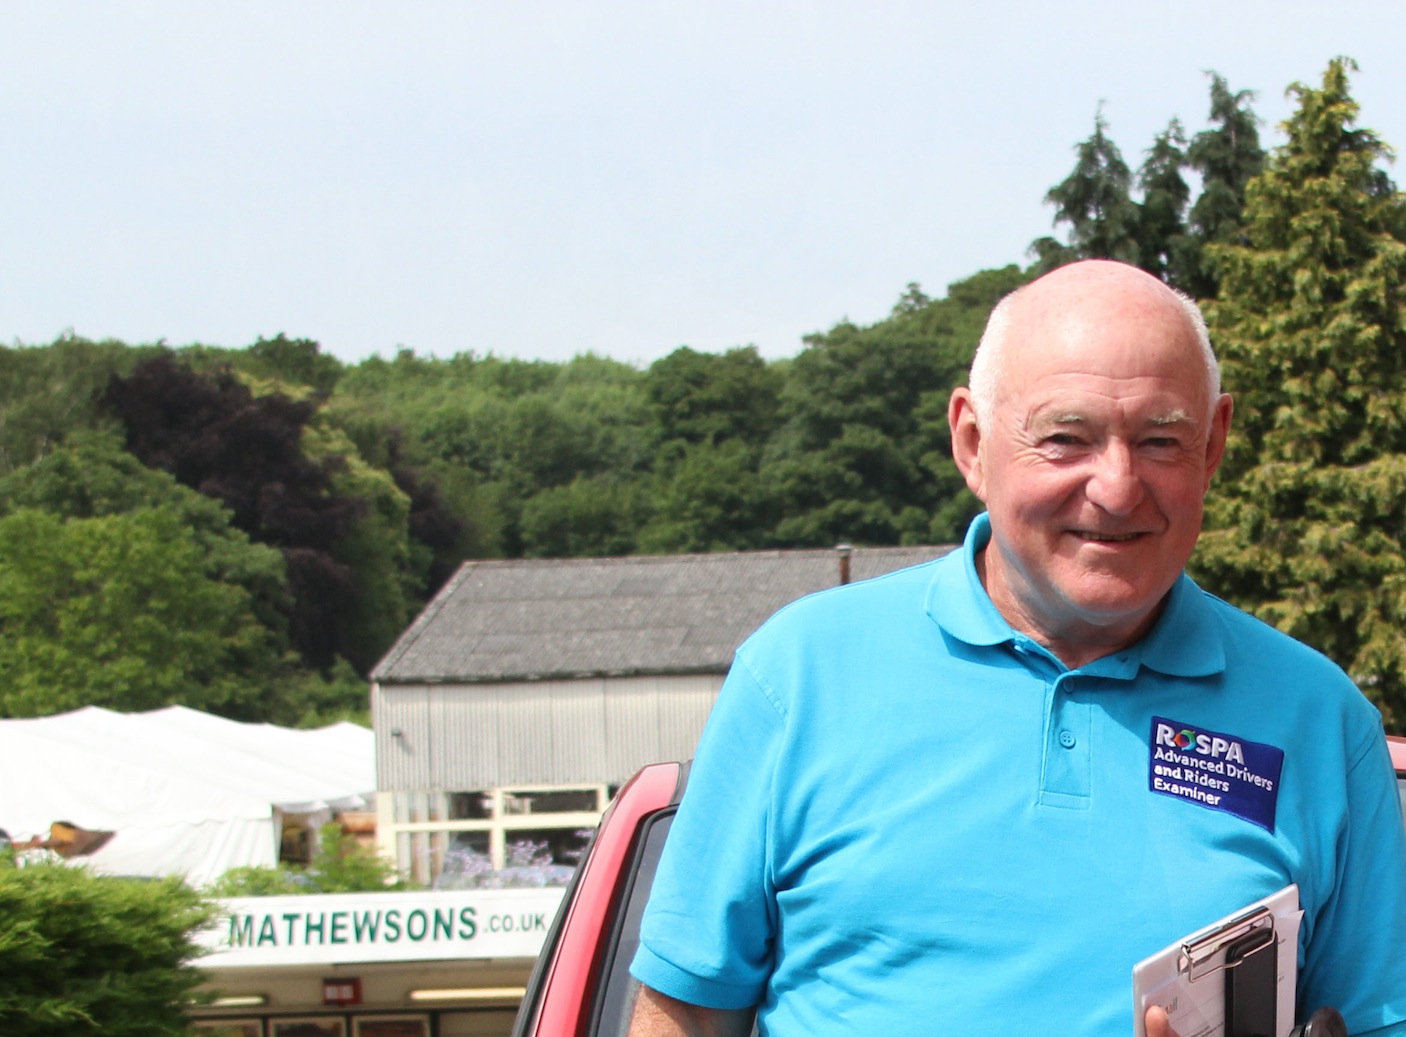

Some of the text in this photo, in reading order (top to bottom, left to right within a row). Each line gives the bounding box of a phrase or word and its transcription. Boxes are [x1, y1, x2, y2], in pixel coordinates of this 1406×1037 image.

[1154, 747, 1273, 791] Advanced Drivers
[1154, 765, 1230, 792] and Riders
[1153, 777, 1221, 805] Examiner
